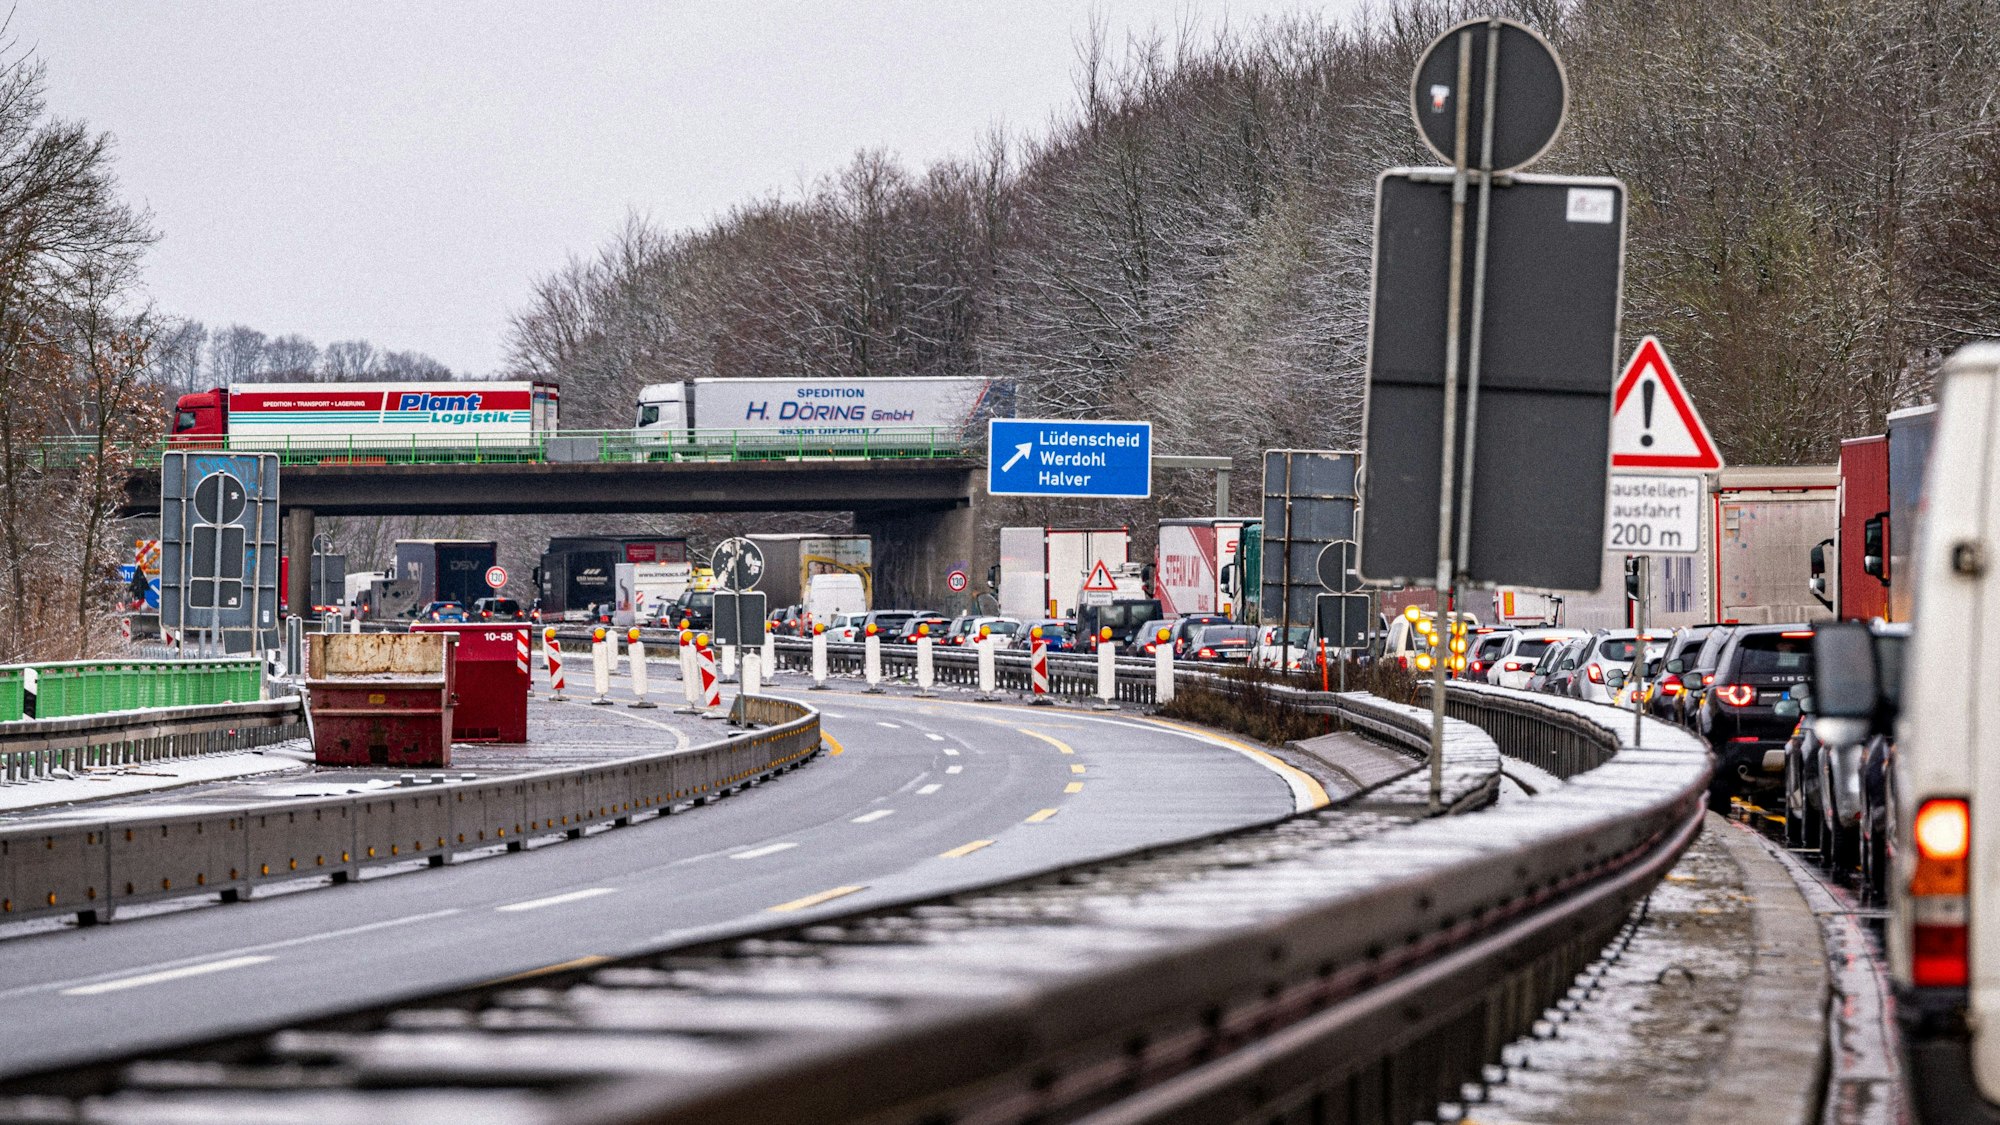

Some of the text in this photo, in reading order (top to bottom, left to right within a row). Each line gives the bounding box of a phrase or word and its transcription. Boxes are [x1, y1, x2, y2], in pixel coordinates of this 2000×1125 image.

[797, 388, 864, 398] SPEDITION
[400, 393, 482, 411] Plant
[746, 400, 915, 421] H. DÖRING GmbH
[431, 411, 511, 425] Logistik
[1039, 431, 1140, 447] Lüdenscheid
[1040, 451, 1106, 467] Werdohl
[1039, 471, 1091, 487] Halver
[1612, 484, 1695, 496] austellen-
[1612, 504, 1681, 518] ausfahrt
[1612, 523, 1681, 546] 200 m
[450, 560, 480, 570] DSV
[490, 572, 503, 582] 130
[951, 577, 964, 587] 130
[484, 632, 514, 642] 10-58
